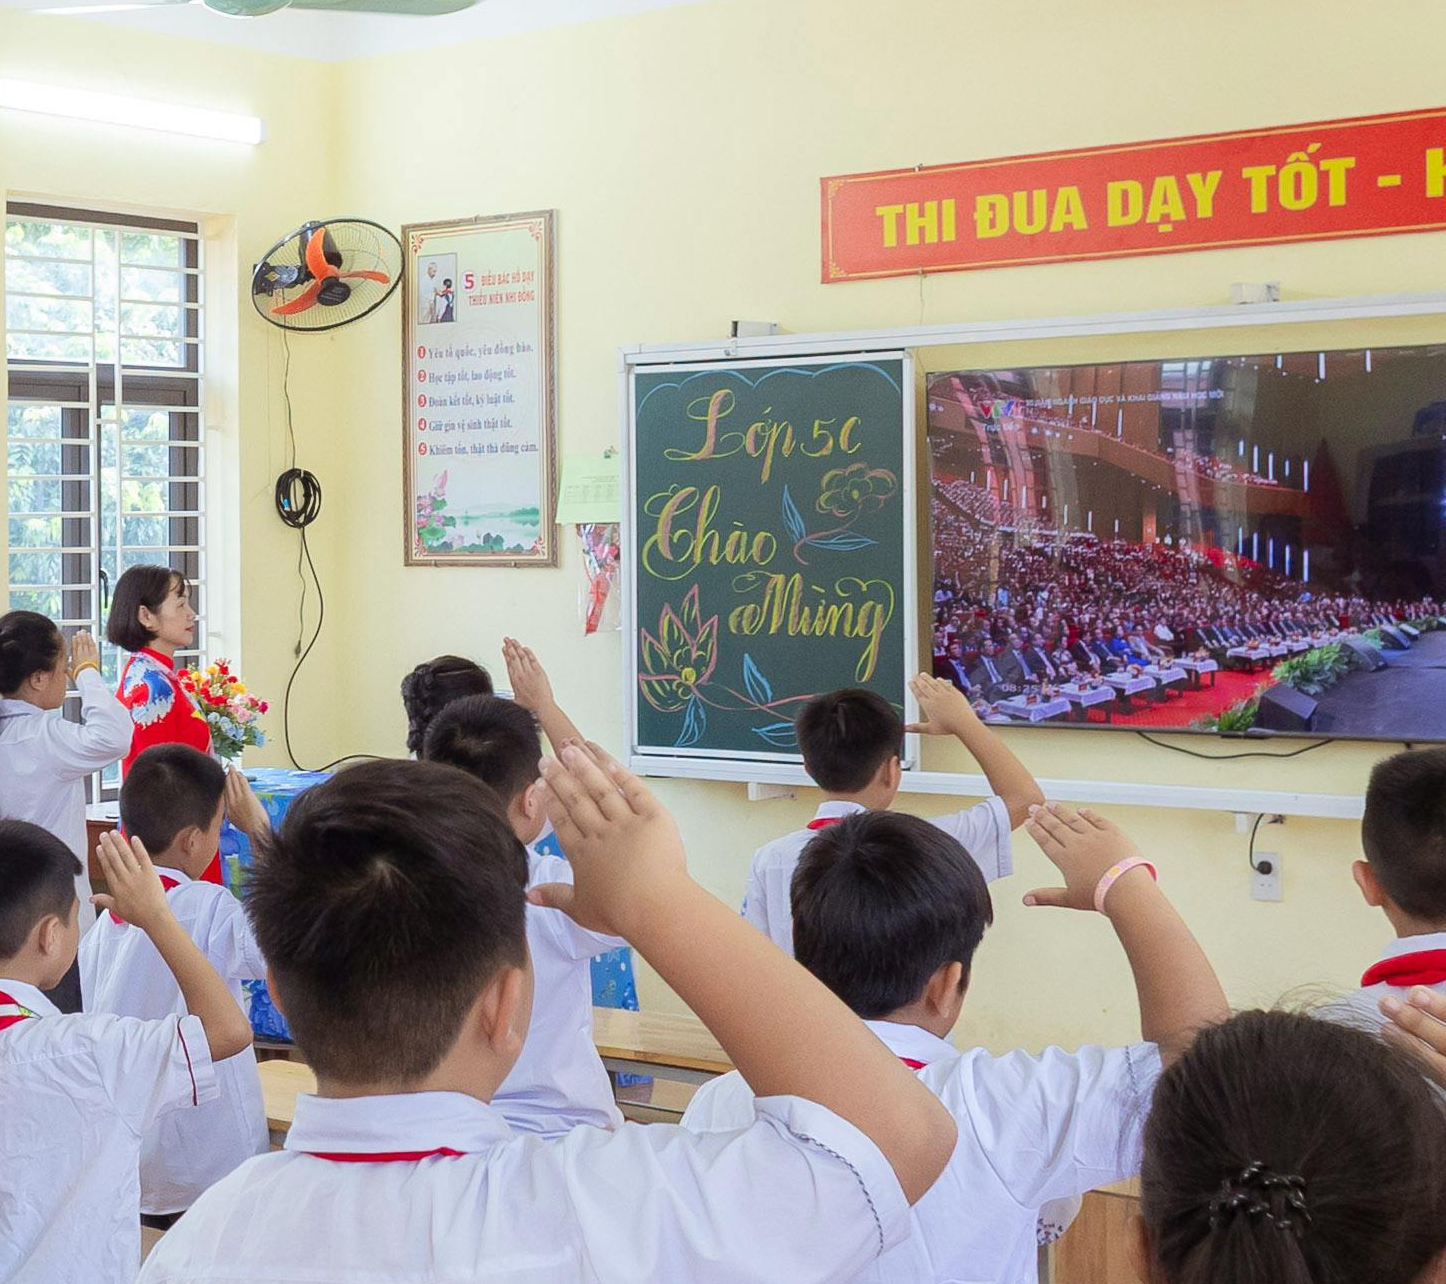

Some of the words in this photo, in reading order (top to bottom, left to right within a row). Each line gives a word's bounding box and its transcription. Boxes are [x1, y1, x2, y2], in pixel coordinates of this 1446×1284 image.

[875, 198, 957, 248] THI
[973, 184, 1088, 239] ĐUA
[1107, 172, 1218, 234] DẠY
[1243, 142, 1355, 214] TỐT
[1377, 172, 1402, 190] -
[465, 274, 474, 289] 5
[664, 389, 797, 484] Lớp
[642, 484, 777, 580] Chào
[729, 570, 895, 683] Mừng
